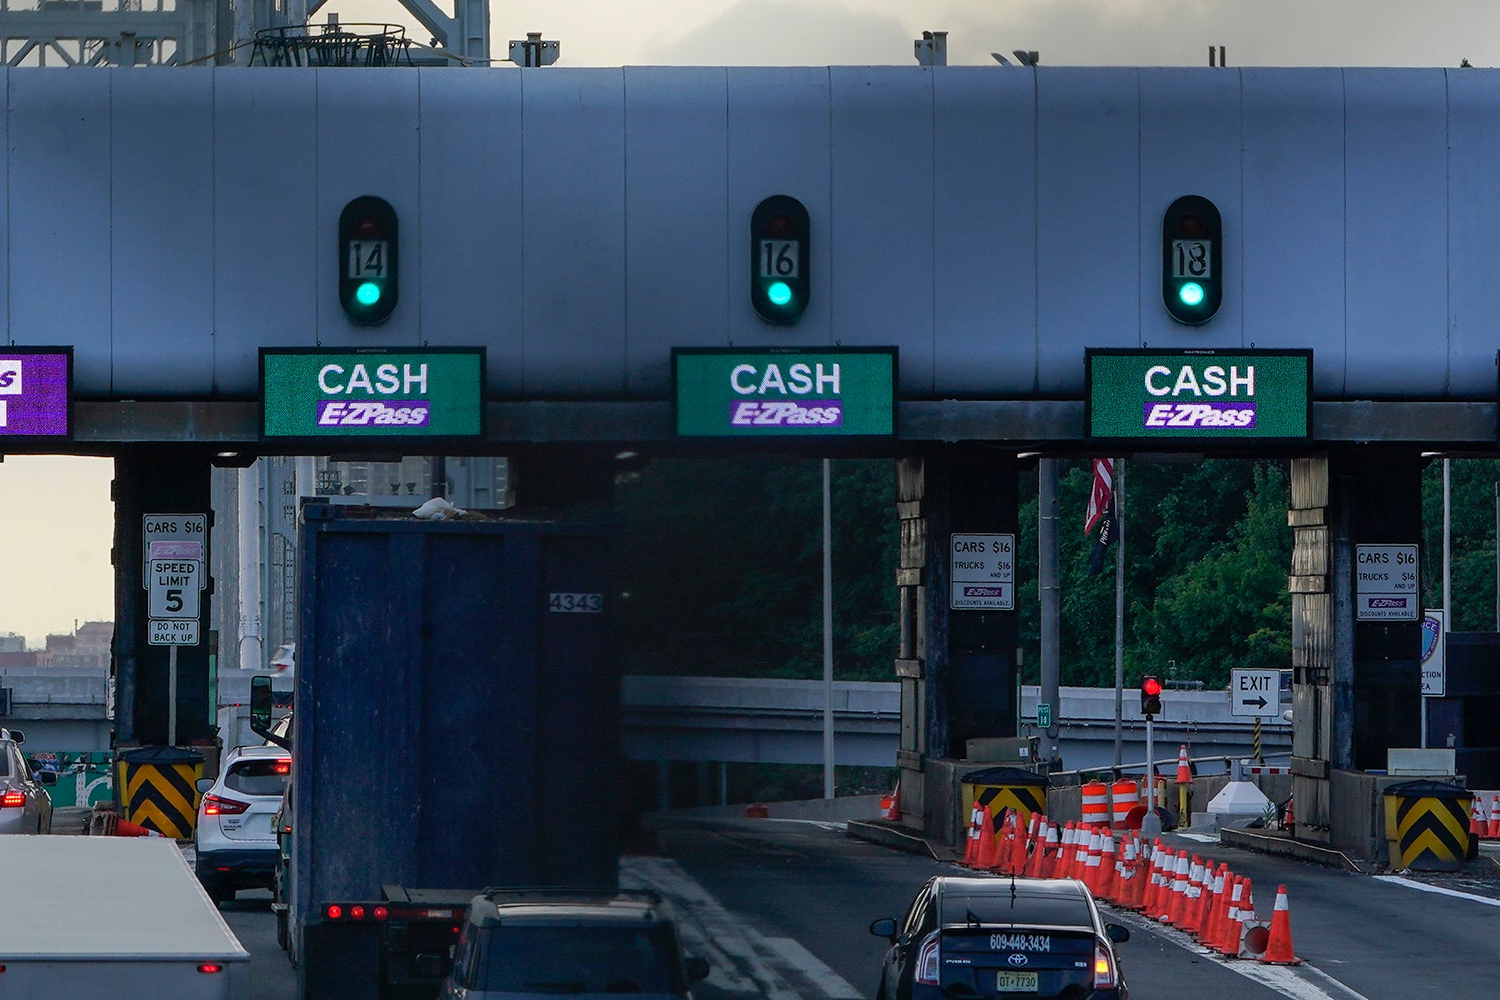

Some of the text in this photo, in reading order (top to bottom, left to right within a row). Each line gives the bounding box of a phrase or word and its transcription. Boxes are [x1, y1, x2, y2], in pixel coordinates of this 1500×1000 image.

[353, 243, 383, 276] 14
[764, 242, 793, 276] 16
[1176, 242, 1206, 276] 18
[318, 363, 427, 394] CASH
[730, 363, 840, 394] CASH
[1144, 365, 1254, 396] CASH
[146, 521, 203, 534] CARS $16
[954, 541, 1011, 553] CARS $16
[955, 561, 1011, 570] TRUCKS $16
[1358, 552, 1415, 565] CARS $16
[156, 563, 195, 573] SPEED
[159, 576, 190, 586] LIMIT
[1358, 572, 1415, 581] TRUCKS $16
[166, 589, 183, 612] 5
[549, 595, 602, 611] 4343
[157, 623, 190, 631] DO NOT
[154, 634, 193, 642] BACK UP
[1240, 676, 1271, 691] EXIT
[990, 933, 1051, 952] 609-448-3434
